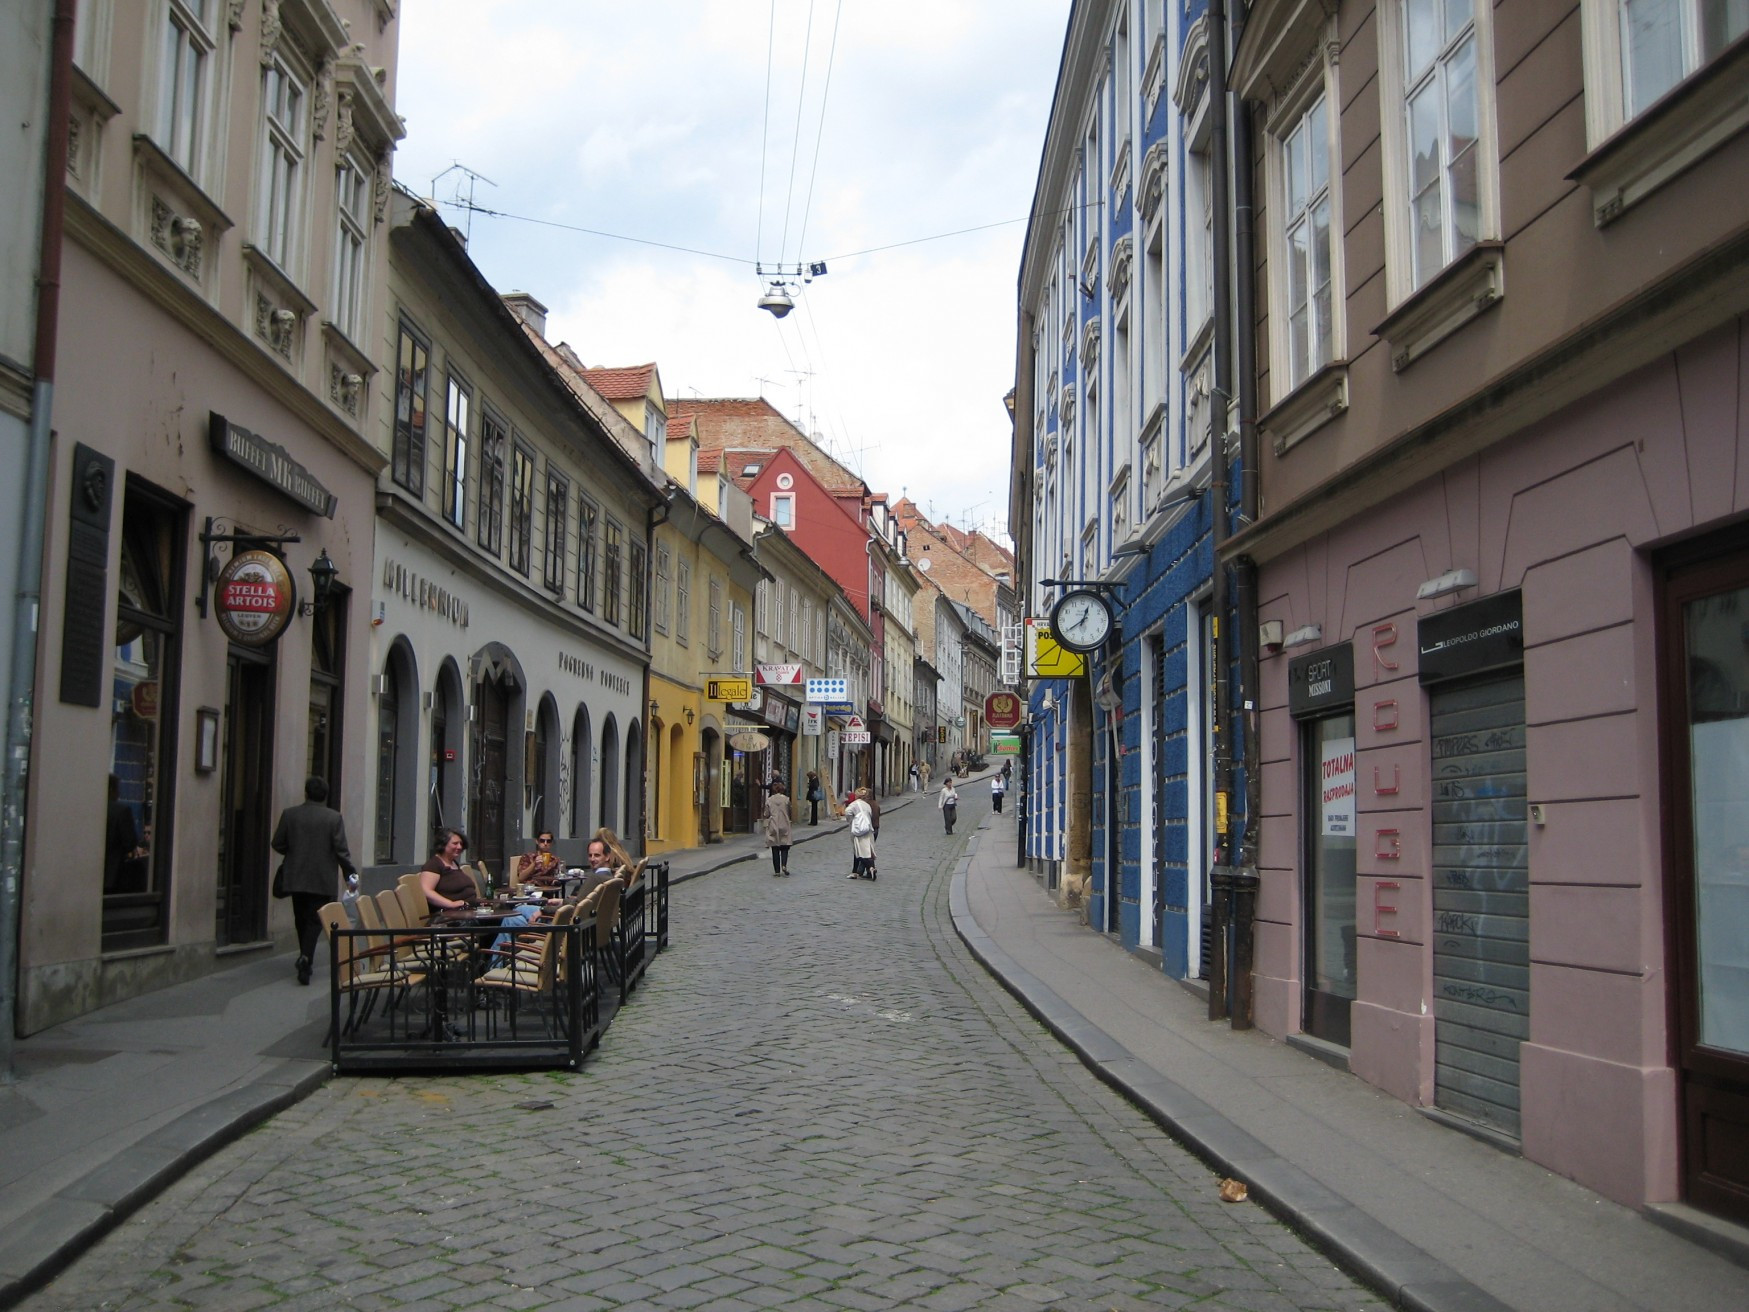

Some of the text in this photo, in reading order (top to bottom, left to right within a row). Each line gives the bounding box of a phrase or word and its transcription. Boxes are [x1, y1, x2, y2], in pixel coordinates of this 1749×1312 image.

[229, 429, 324, 509] BUFFET MK BUFFET
[227, 596, 276, 608] ARTOIS
[228, 585, 276, 597] STELLA
[1443, 620, 1519, 648] LEOPOLDO GIORDANO
[1308, 659, 1331, 682] SPORT
[1322, 752, 1354, 779] TOTALNA
[1372, 622, 1400, 938] ROUGE
